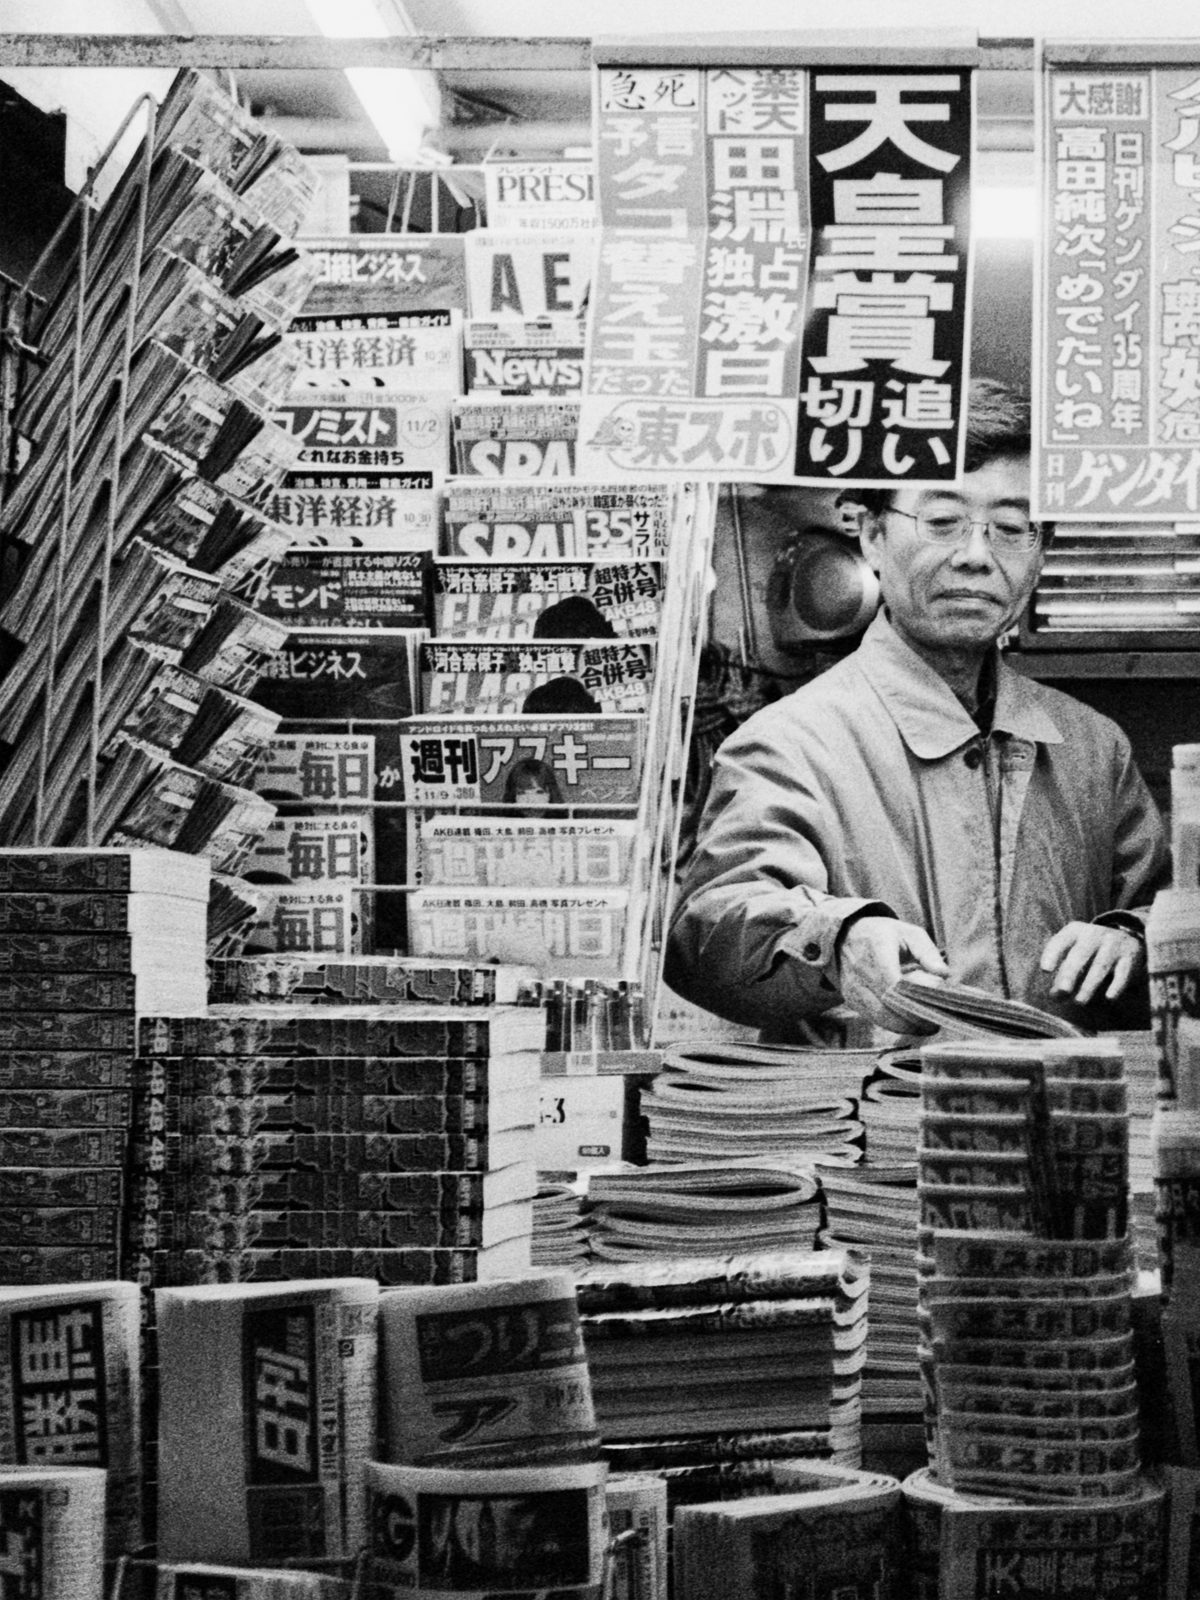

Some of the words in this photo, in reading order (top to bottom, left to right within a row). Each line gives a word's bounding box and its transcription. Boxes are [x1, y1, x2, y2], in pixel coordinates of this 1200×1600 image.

[604, 71, 697, 111] 急死
[1059, 81, 1144, 117] 大感謝
[632, 406, 780, 467] 東スポ
[593, 562, 649, 585] 超特大
[591, 577, 658, 609] 合併号
[583, 644, 639, 667] 超特大
[580, 659, 649, 690] 合併号
